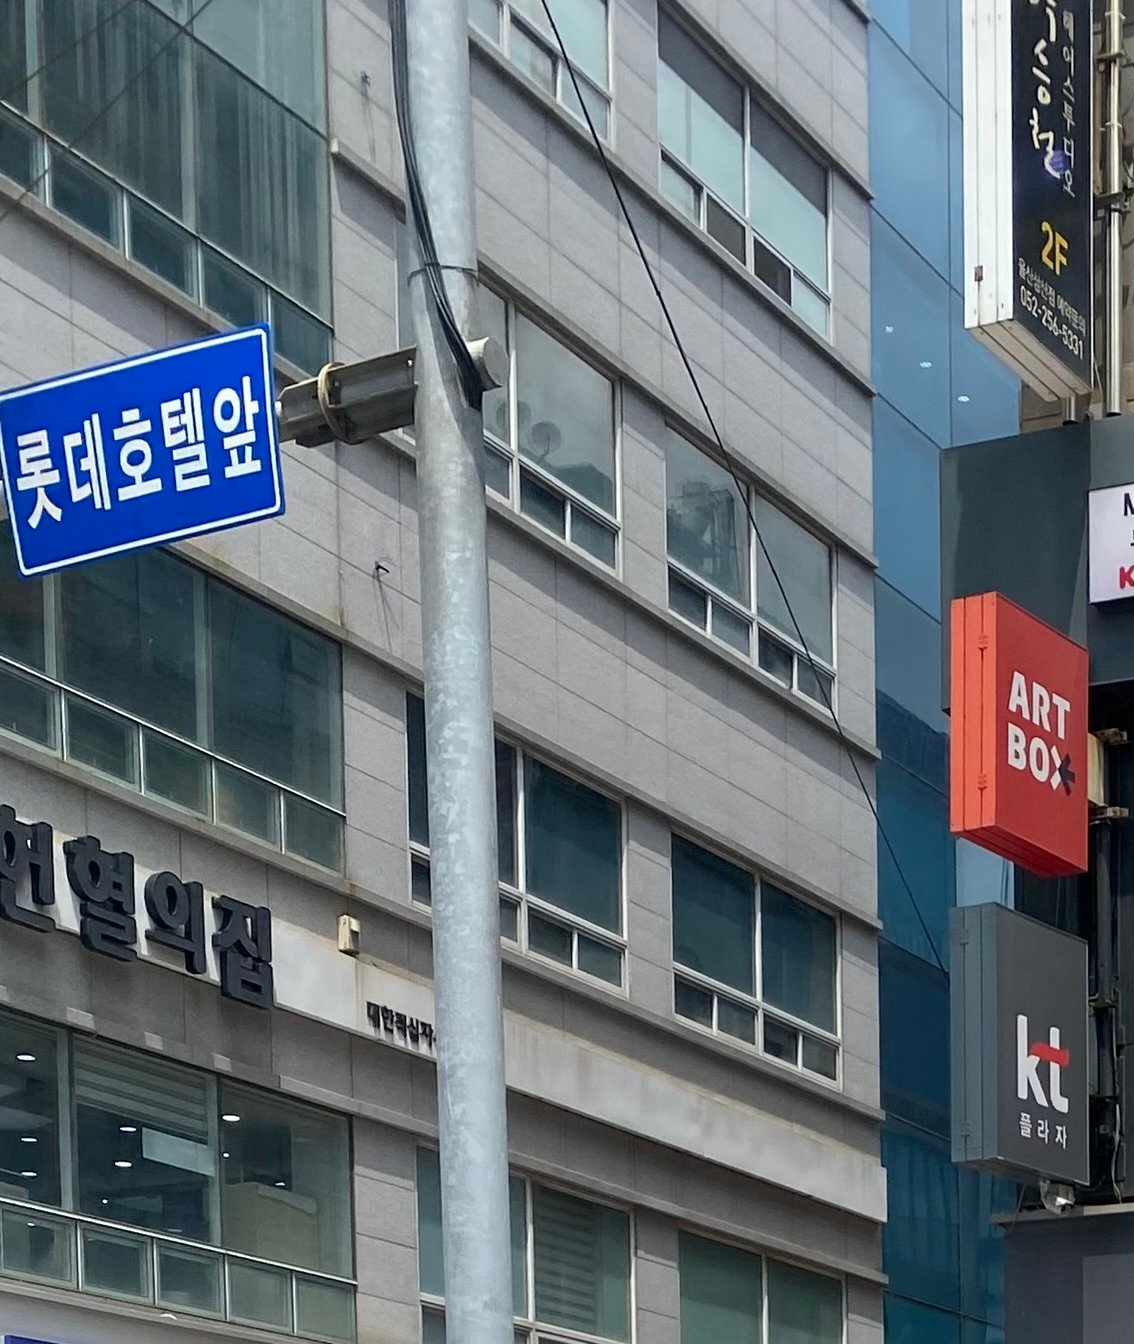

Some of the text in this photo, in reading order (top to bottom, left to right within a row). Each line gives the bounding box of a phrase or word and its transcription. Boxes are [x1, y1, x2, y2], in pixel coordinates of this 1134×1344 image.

[1041, 221, 1069, 276] 2F
[1020, 285, 1084, 360] 052-256-5331
[16, 375, 262, 529] 롯데호텔앞
[1008, 670, 1071, 740] ART
[1008, 722, 1075, 796] BOX
[366, 1001, 436, 1049] 대한적십자
[1017, 1014, 1070, 1114] kt
[1019, 1111, 1068, 1150] 플라자
